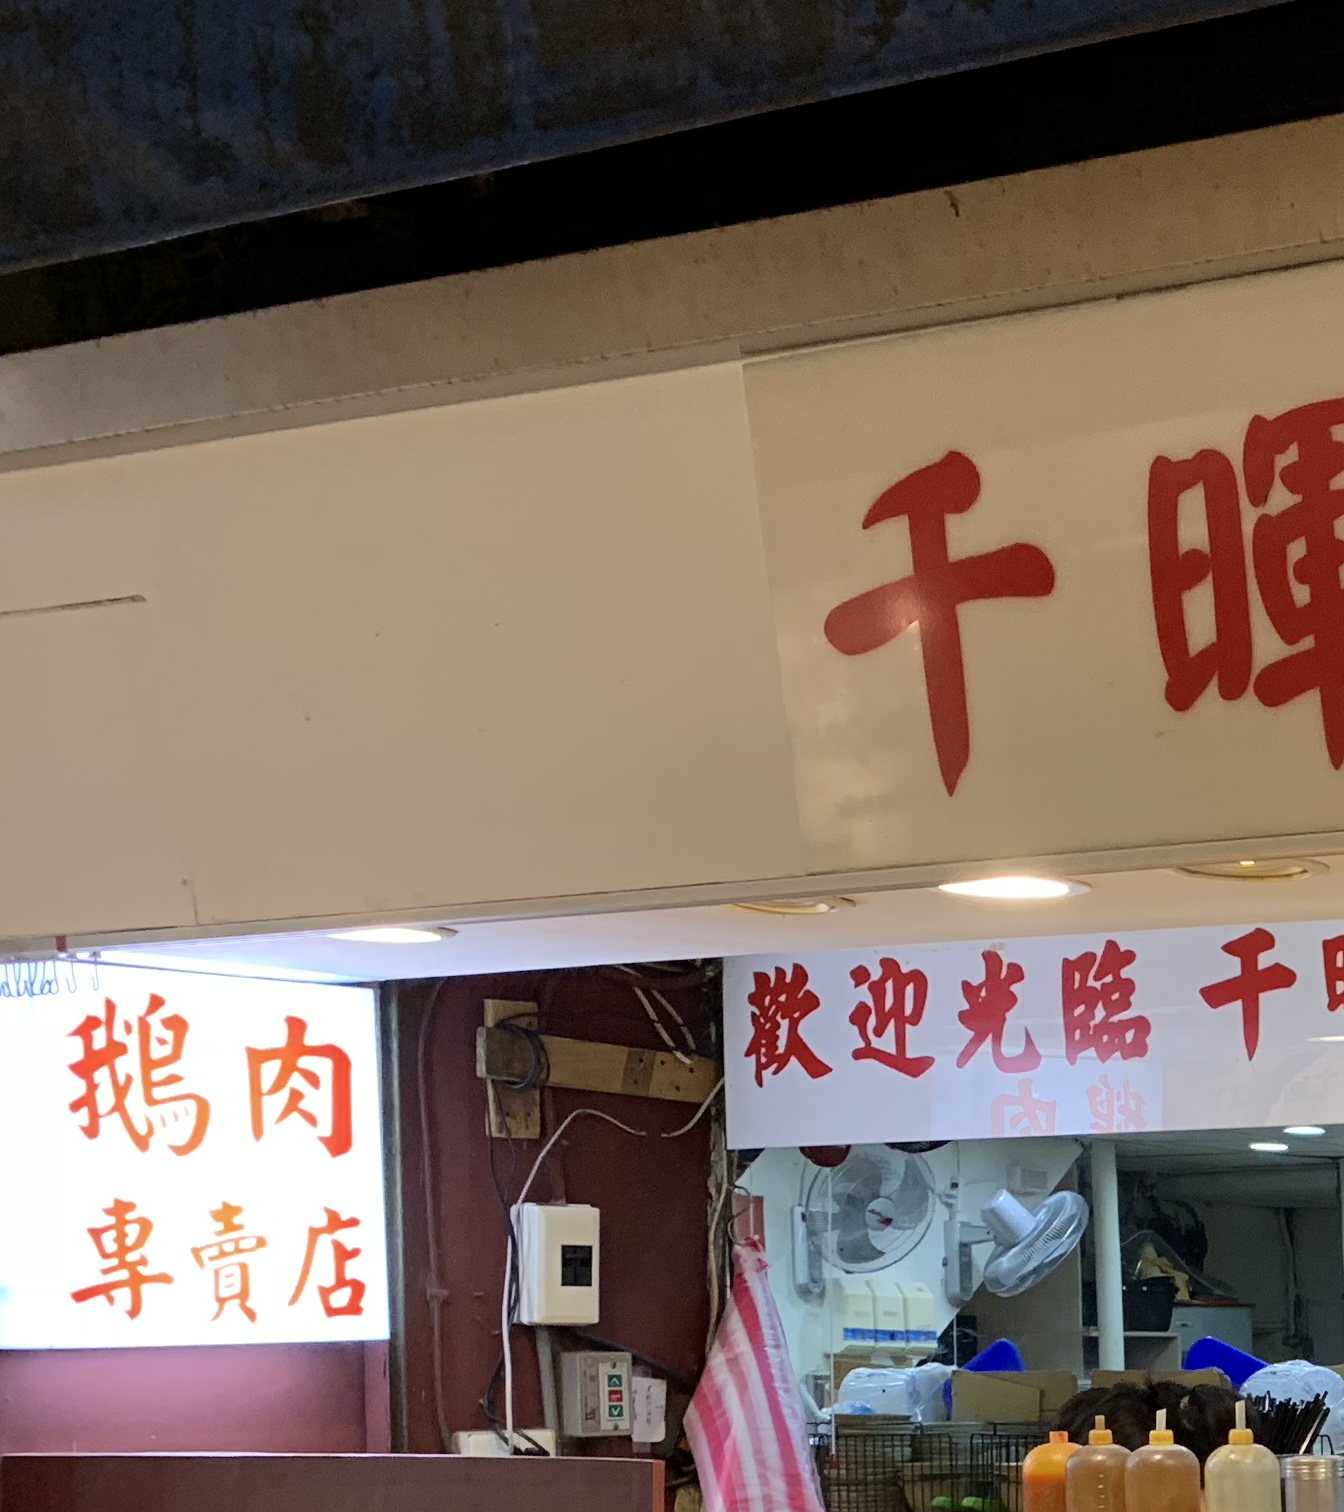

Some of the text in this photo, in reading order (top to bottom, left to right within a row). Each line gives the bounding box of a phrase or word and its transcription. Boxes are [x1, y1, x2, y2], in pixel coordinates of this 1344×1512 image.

[66, 992, 354, 1159] 鵝肉
[744, 938, 1152, 1088] 歡迎光臨
[69, 1197, 367, 1324] 專賣店
